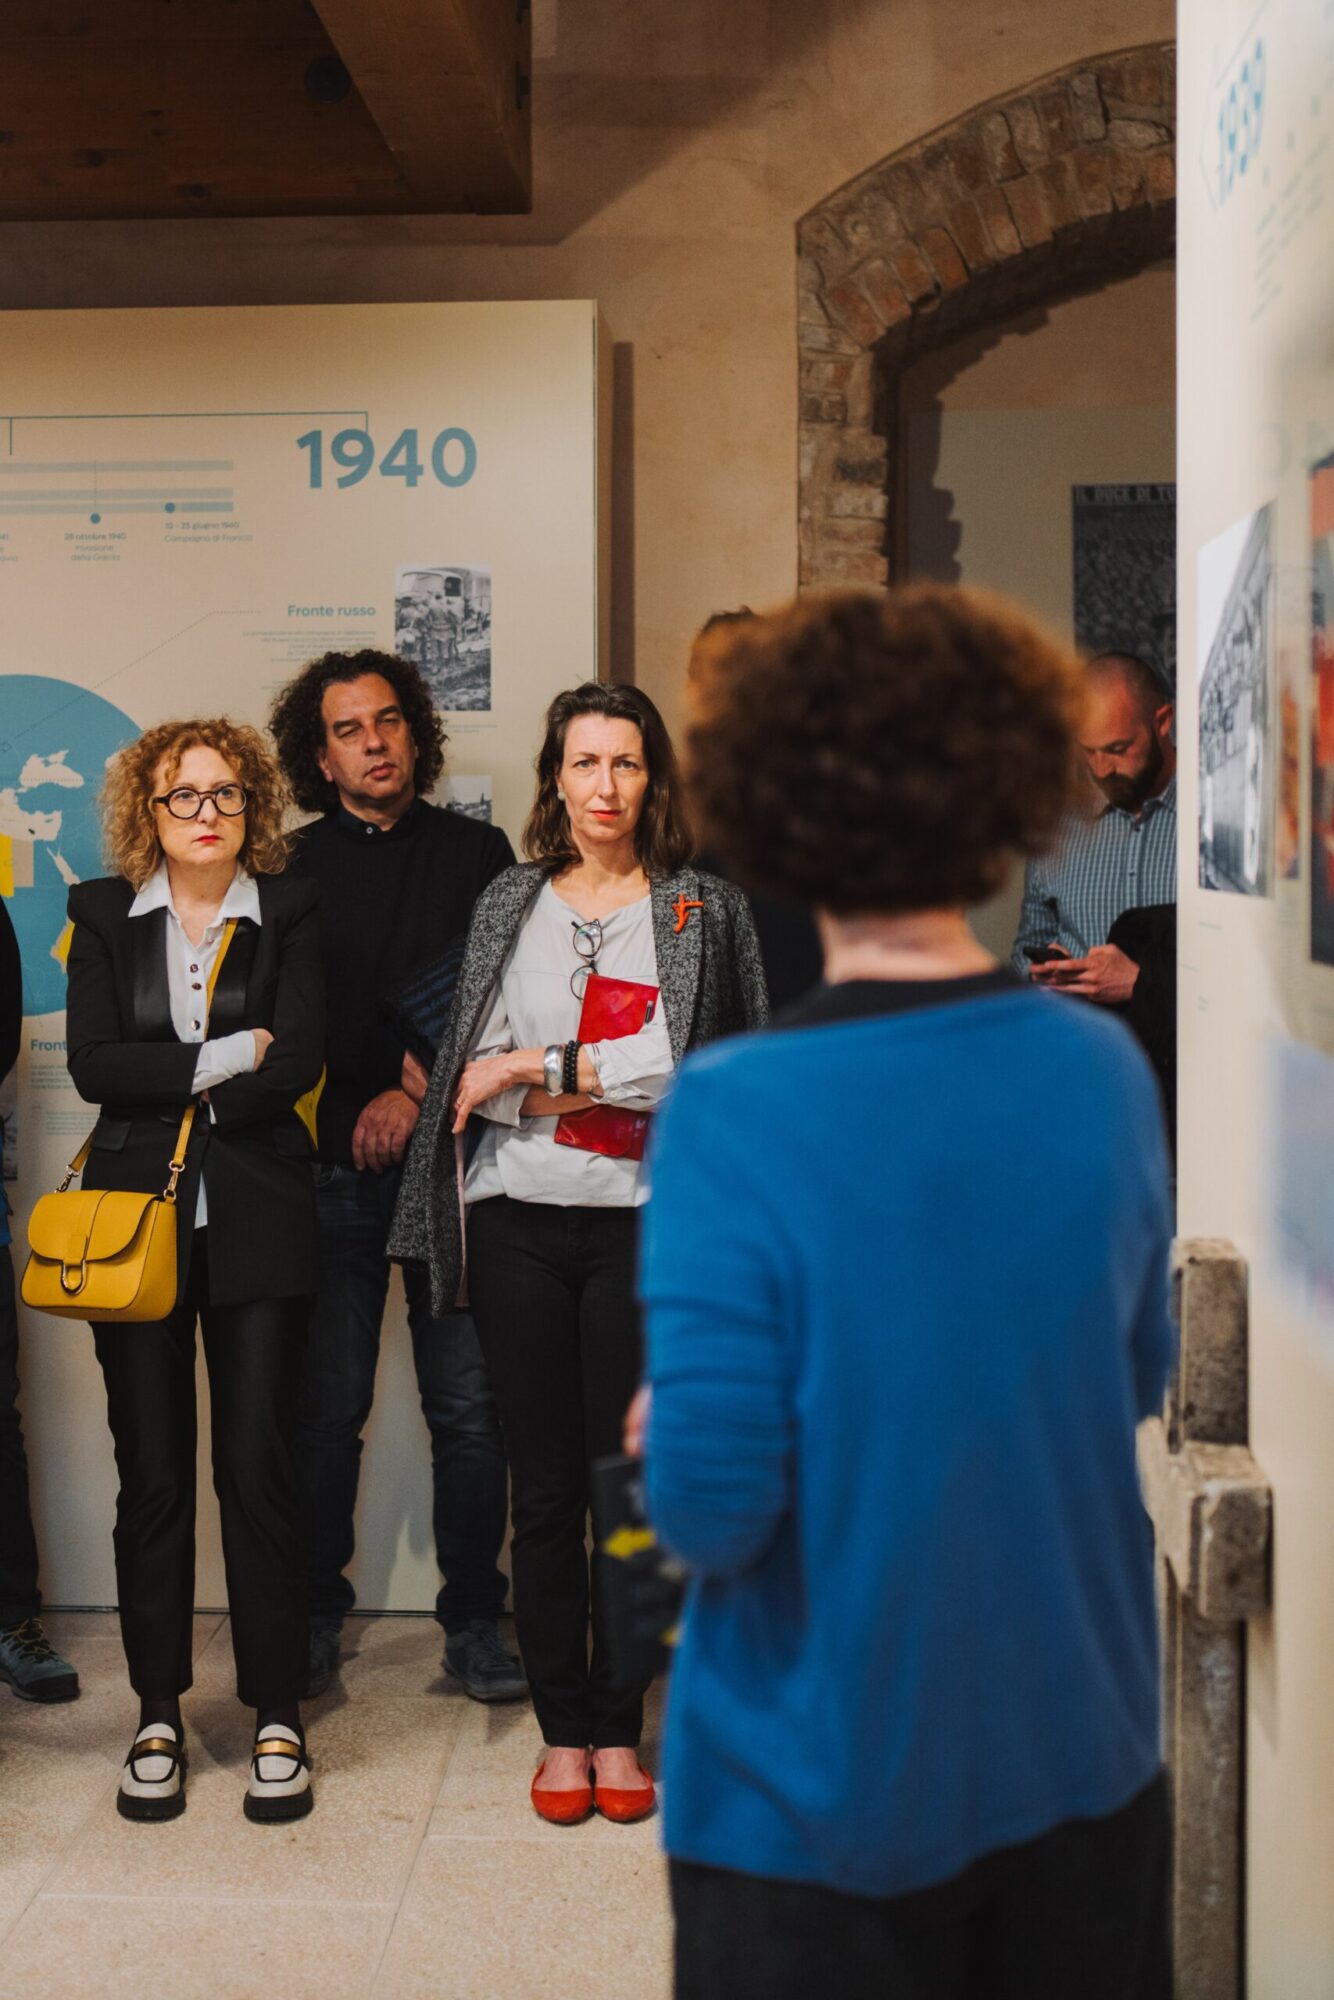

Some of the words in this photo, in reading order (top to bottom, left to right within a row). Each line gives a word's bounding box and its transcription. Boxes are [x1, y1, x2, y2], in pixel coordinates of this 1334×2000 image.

[296, 427, 477, 489] 1940
[288, 605, 334, 617] Fronte
[337, 607, 377, 617] russo
[31, 1039, 67, 1051] Front
